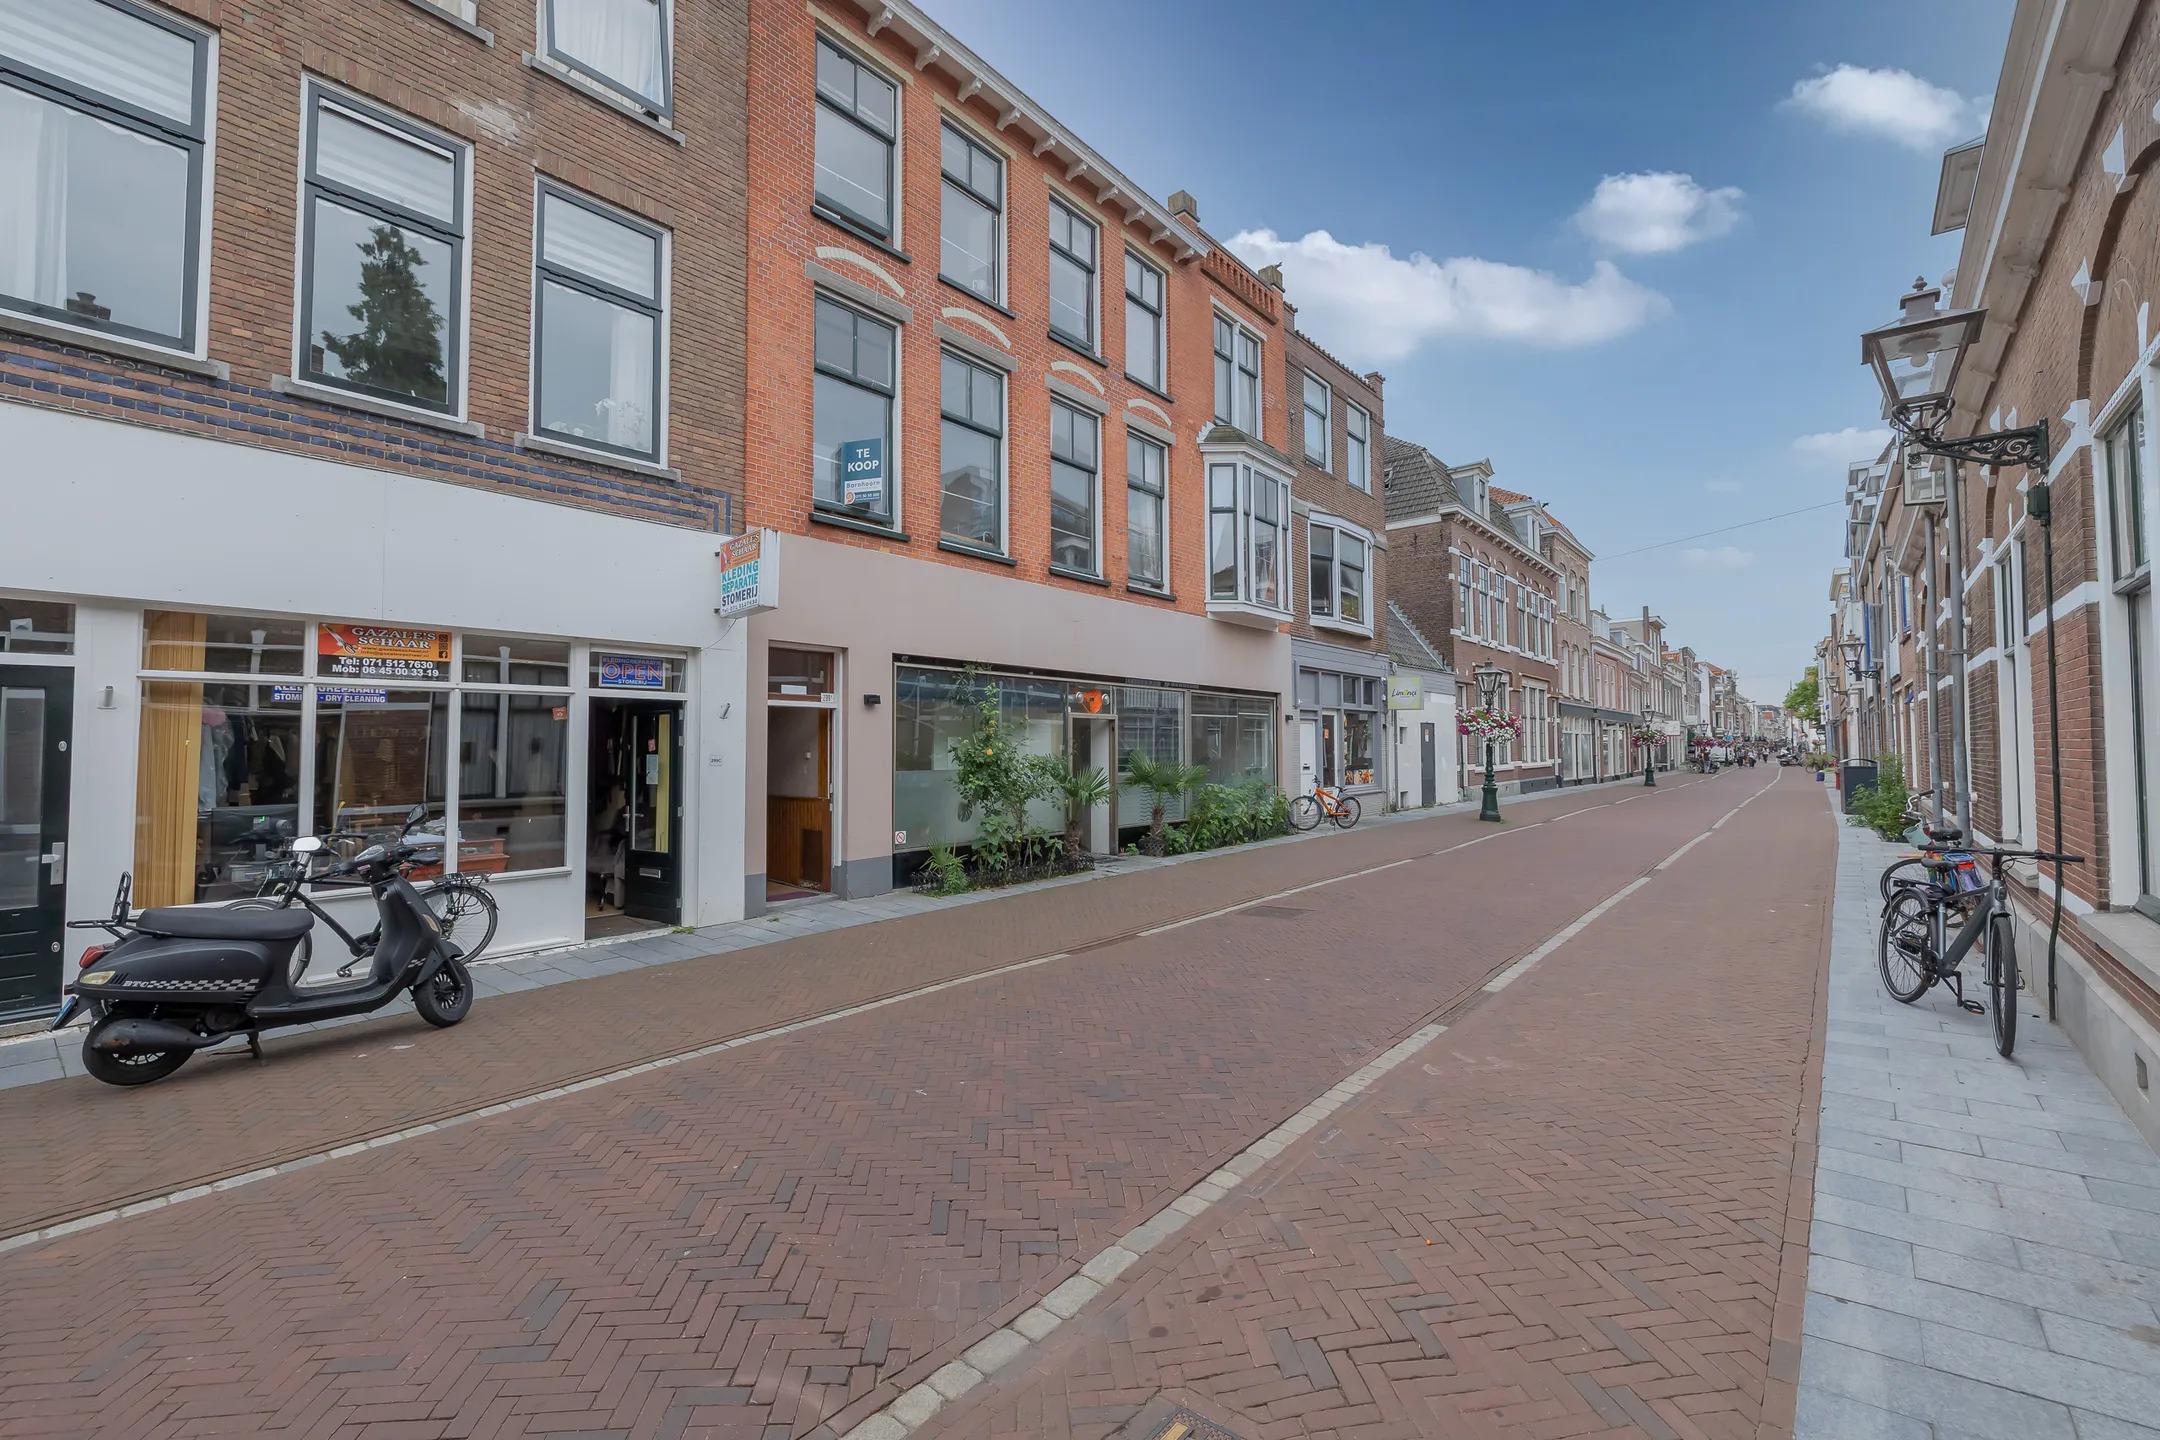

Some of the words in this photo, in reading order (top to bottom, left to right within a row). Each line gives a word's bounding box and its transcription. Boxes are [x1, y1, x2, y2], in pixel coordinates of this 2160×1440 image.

[856, 448, 870, 458] TE
[847, 460, 879, 472] KOOP
[846, 481, 880, 489] Barnhoorn
[730, 533, 760, 551] GAZALE'S
[731, 543, 757, 558] SCHAAR
[722, 560, 759, 583] KLEDING
[722, 573, 758, 595] REPARATIE
[722, 585, 758, 607] STOMERIJ
[351, 627, 437, 640] GAZALE'S
[358, 637, 431, 649] SCHAAR
[339, 656, 360, 665] Tel:
[362, 658, 382, 666] 071
[386, 659, 405, 668] 512
[408, 660, 433, 669] 7630
[332, 664, 360, 673] Mob:
[362, 666, 376, 674] 06
[379, 667, 394, 675] 45
[395, 668, 408, 676] 00
[410, 669, 424, 677] 33
[426, 669, 439, 677] 19
[602, 662, 662, 681] OPEN
[325, 694, 342, 702] DRY
[344, 695, 386, 703] CLEANING
